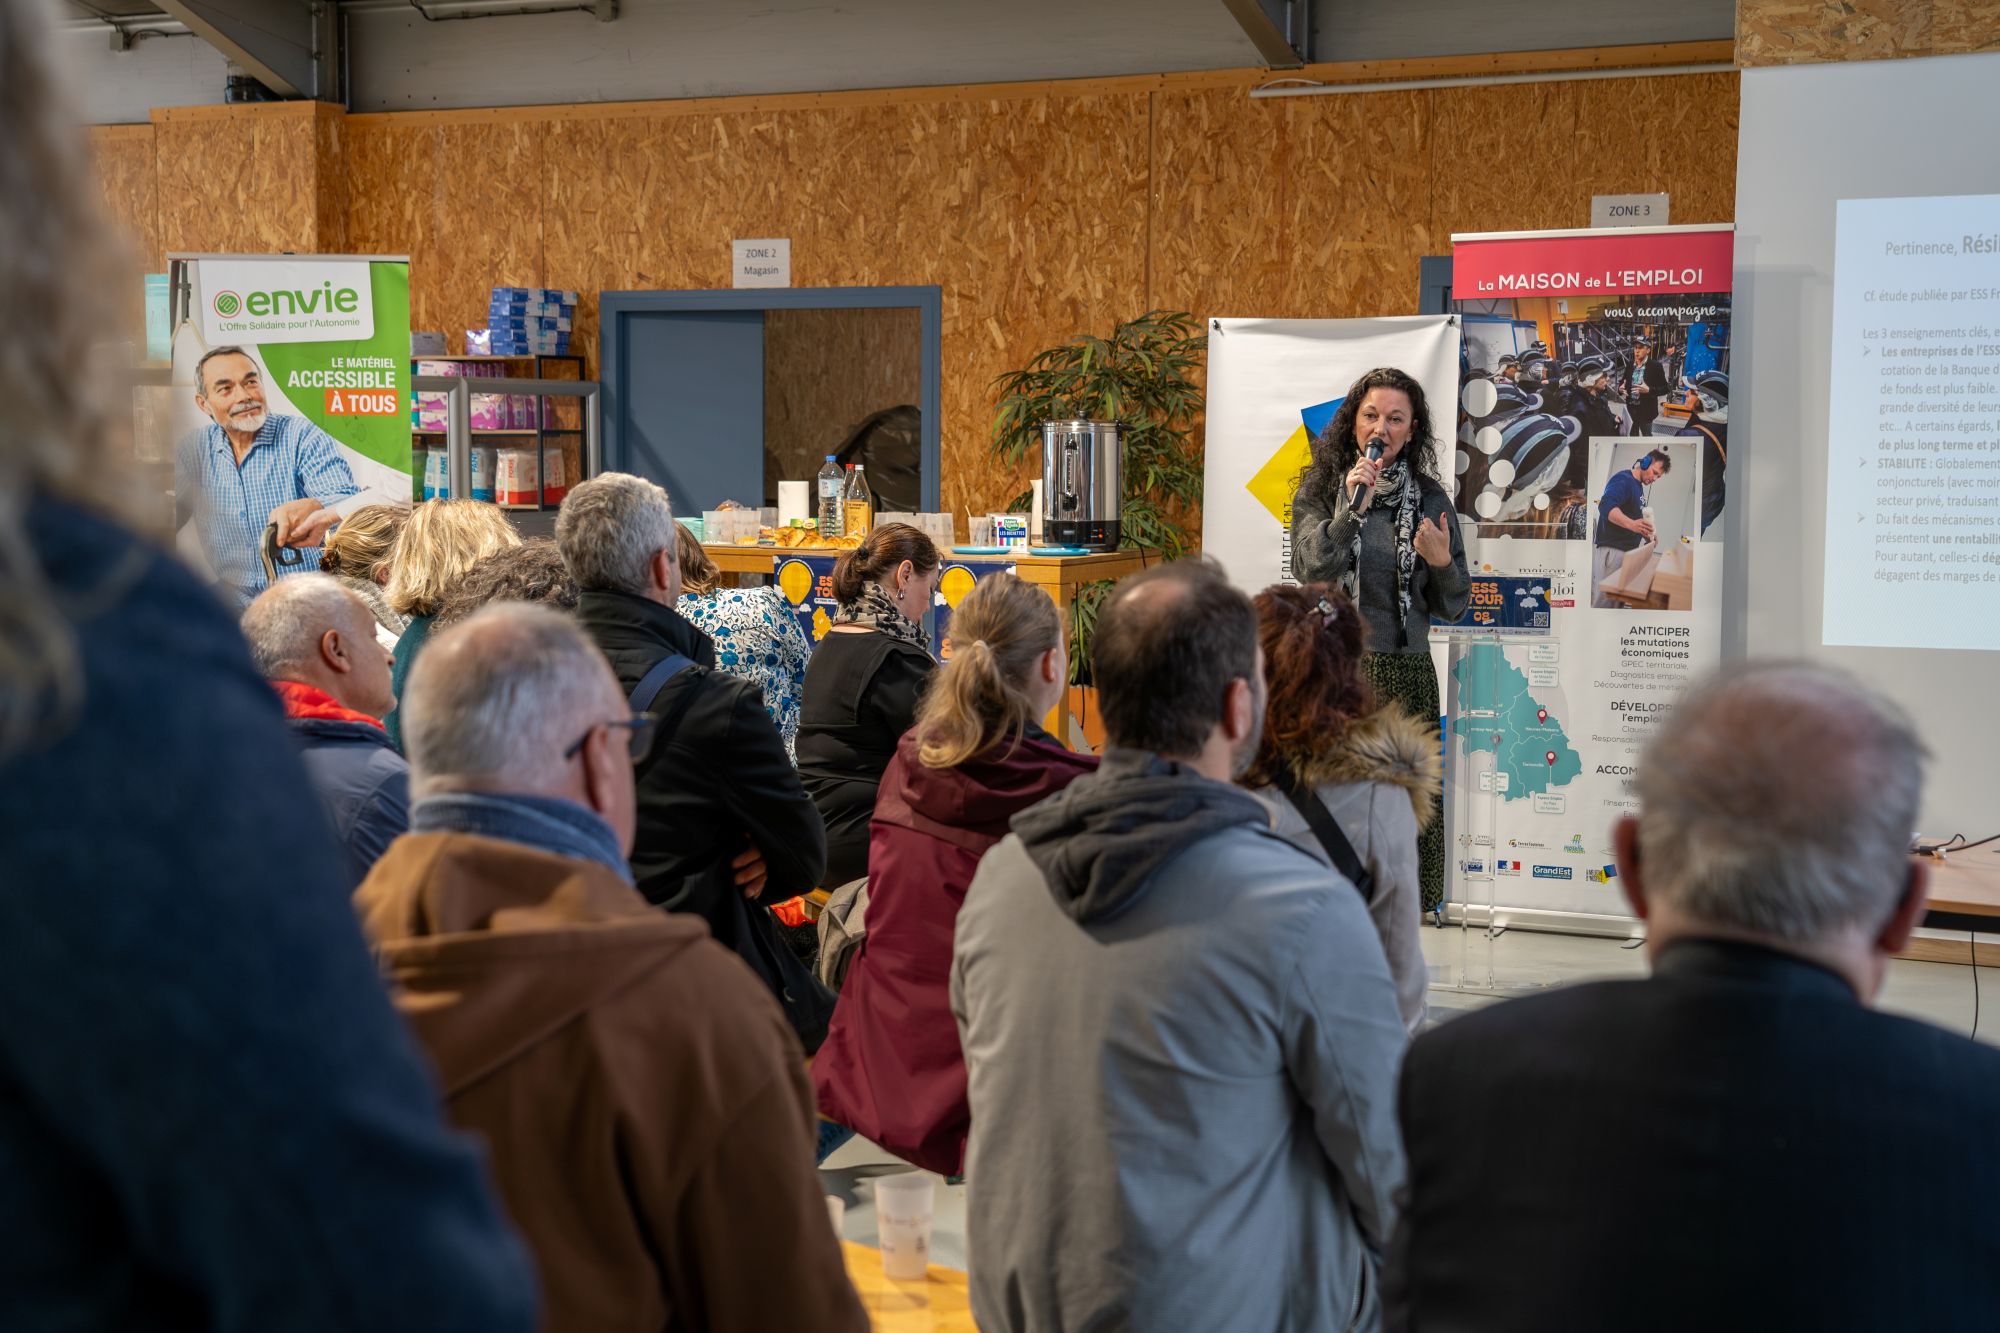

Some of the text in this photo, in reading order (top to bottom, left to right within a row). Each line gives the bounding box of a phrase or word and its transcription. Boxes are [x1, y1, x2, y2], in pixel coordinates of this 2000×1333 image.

[1609, 205, 1650, 217] ZONE 3
[745, 248, 777, 258] ZONE 2
[1885, 242, 1957, 256] Pertinence,
[744, 265, 779, 277] Magasin
[1478, 280, 1494, 291] La
[1498, 272, 1580, 290] MAISON
[1584, 277, 1601, 288] de
[246, 280, 359, 316] envie
[1879, 289, 1908, 302] étude
[1911, 288, 1948, 304] publiée
[1951, 291, 1968, 303] par
[1970, 288, 1988, 300] ESS
[1604, 305, 1716, 322] vous accompagne
[249, 321, 286, 331] Solidaire
[288, 321, 307, 331] pour
[1863, 328, 1879, 339] Les
[1881, 328, 1887, 339] 3
[1890, 327, 1967, 341] enseignements
[1881, 347, 1898, 357] Les
[1901, 345, 1958, 359] entreprises
[1960, 345, 1974, 356] de
[331, 355, 396, 369] LE MATÉRIEL
[1881, 365, 1921, 376] cotation
[1924, 364, 1938, 376] de
[1940, 364, 1949, 376] la
[1951, 364, 1990, 377] Banque
[288, 370, 395, 388] ACCESSIBLE
[1880, 383, 1893, 395] de
[1895, 383, 1923, 395] fonds
[1926, 384, 1941, 394] est
[1943, 382, 1965, 397] plus
[331, 391, 396, 413] À TOUS
[1879, 403, 1914, 415] grande
[1917, 401, 1960, 412] diversité
[1962, 401, 1975, 412] de
[1904, 421, 1913, 432] A
[1915, 421, 1955, 432] certains
[1957, 419, 1994, 434] égards,
[1878, 438, 1891, 450] de
[1894, 439, 1915, 453] plus
[1918, 438, 1940, 452] long
[1943, 440, 1974, 450] terme
[1976, 440, 1988, 450] et
[1877, 458, 1927, 469] STABILITE
[1935, 457, 2000, 469] Globalement
[1877, 476, 1945, 490] conjoncturels
[1947, 475, 1975, 490] (avec
[1876, 494, 1999, 508] secteur privé, traduisant
[1876, 513, 1995, 526] Du fait des mécanismes
[1875, 533, 1930, 545] présentent
[1932, 536, 1952, 544] une
[1875, 550, 1898, 562] Pour
[1901, 552, 1936, 564] autant,
[1939, 551, 1980, 563] celles-ci
[819, 576, 833, 586] ES
[1874, 569, 1996, 584] dégagent des marges de
[1471, 582, 1498, 594] ESS
[1629, 626, 1690, 637] ANTICIPER
[1620, 637, 1690, 648] les mutations
[1621, 648, 1689, 660] économiques
[1621, 660, 1644, 668] GPEC
[1610, 671, 1655, 680] Diagnostics
[1593, 681, 1645, 690] Découvertes
